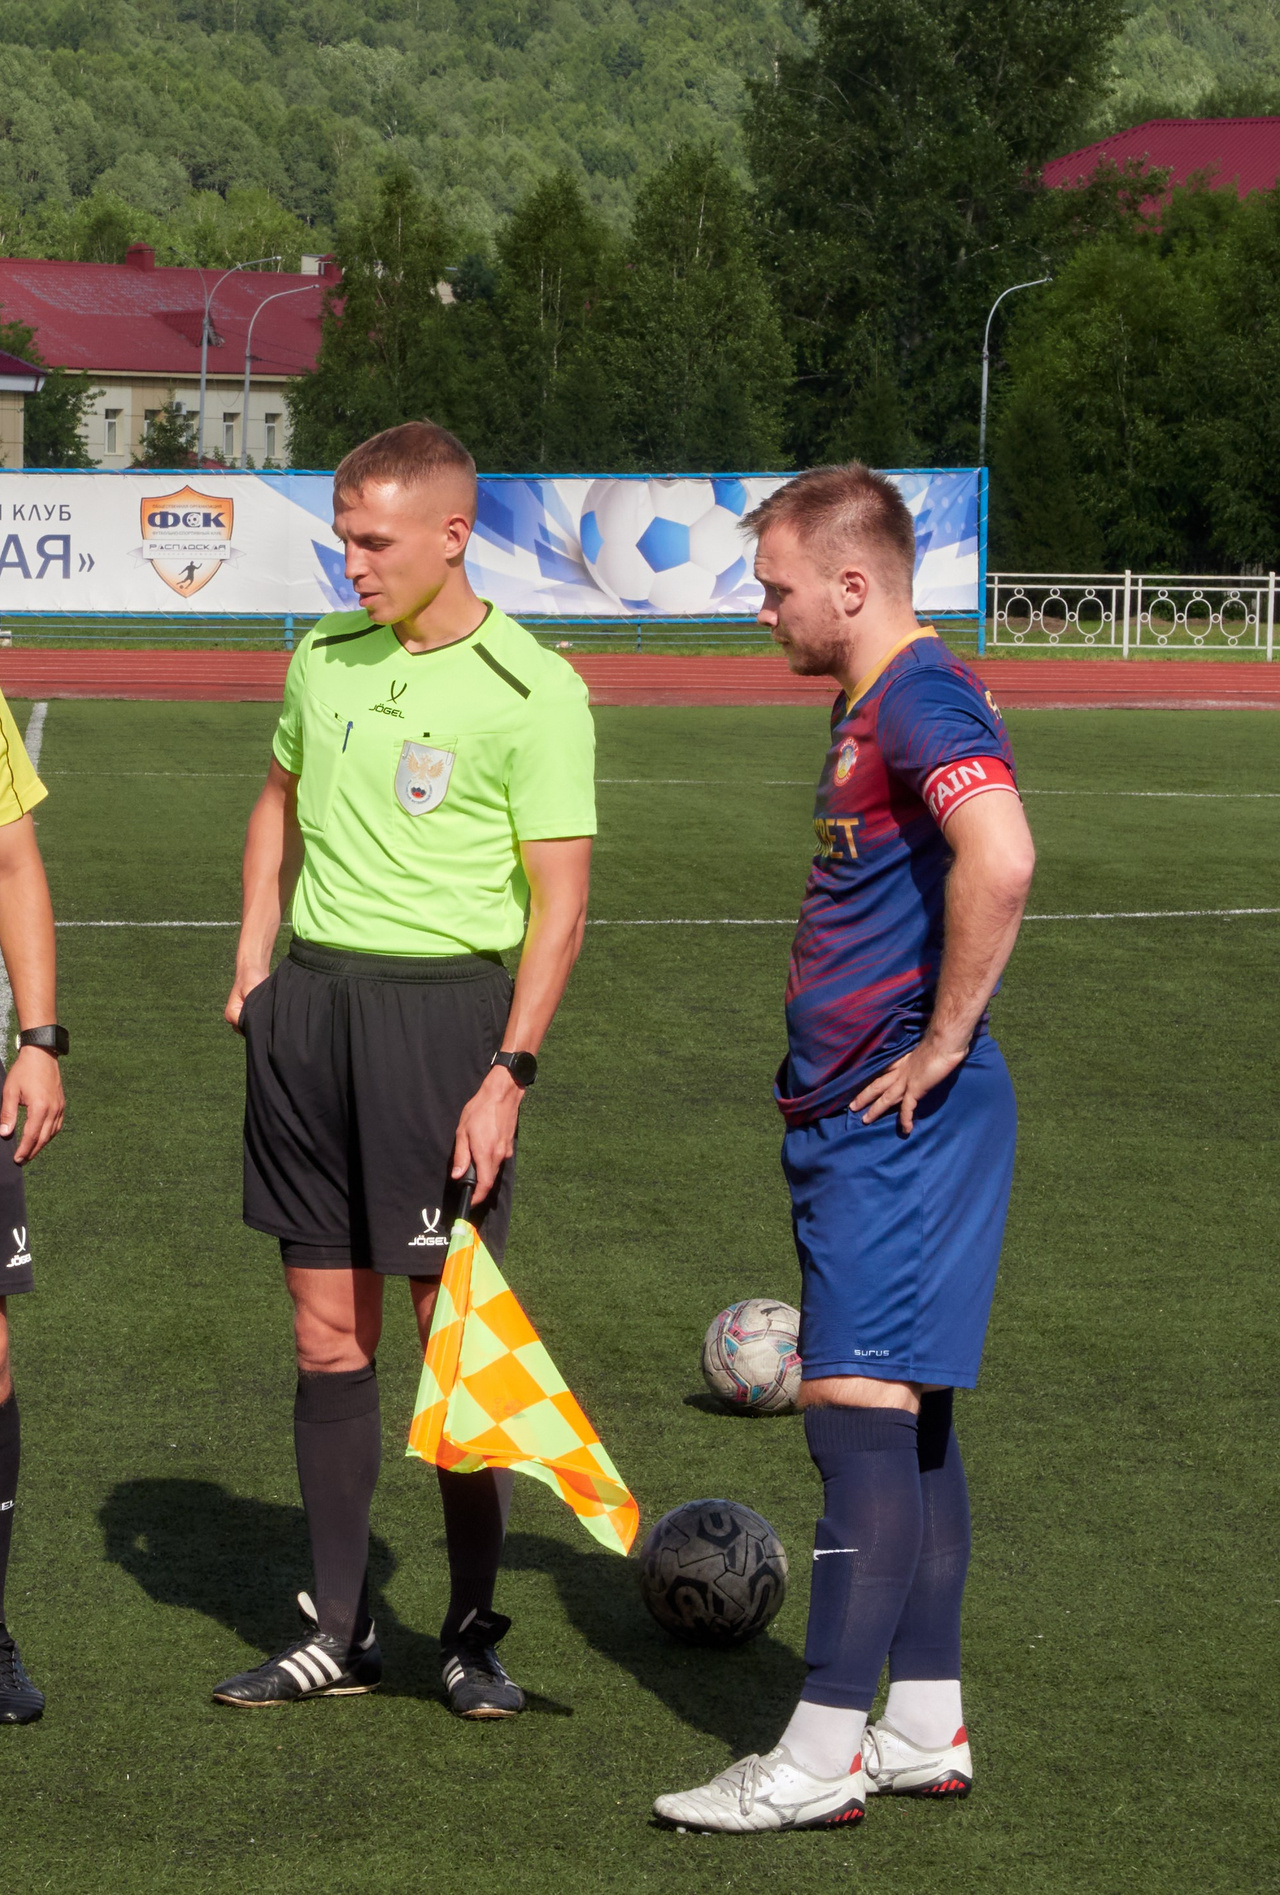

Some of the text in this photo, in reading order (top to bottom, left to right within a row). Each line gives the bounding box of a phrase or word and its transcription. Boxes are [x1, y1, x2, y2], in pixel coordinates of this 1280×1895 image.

[13, 504, 72, 521] КЛУБ
[147, 511, 226, 528] ФСК
[368, 703, 405, 719] JÖGEL
[928, 761, 987, 816] TAIN
